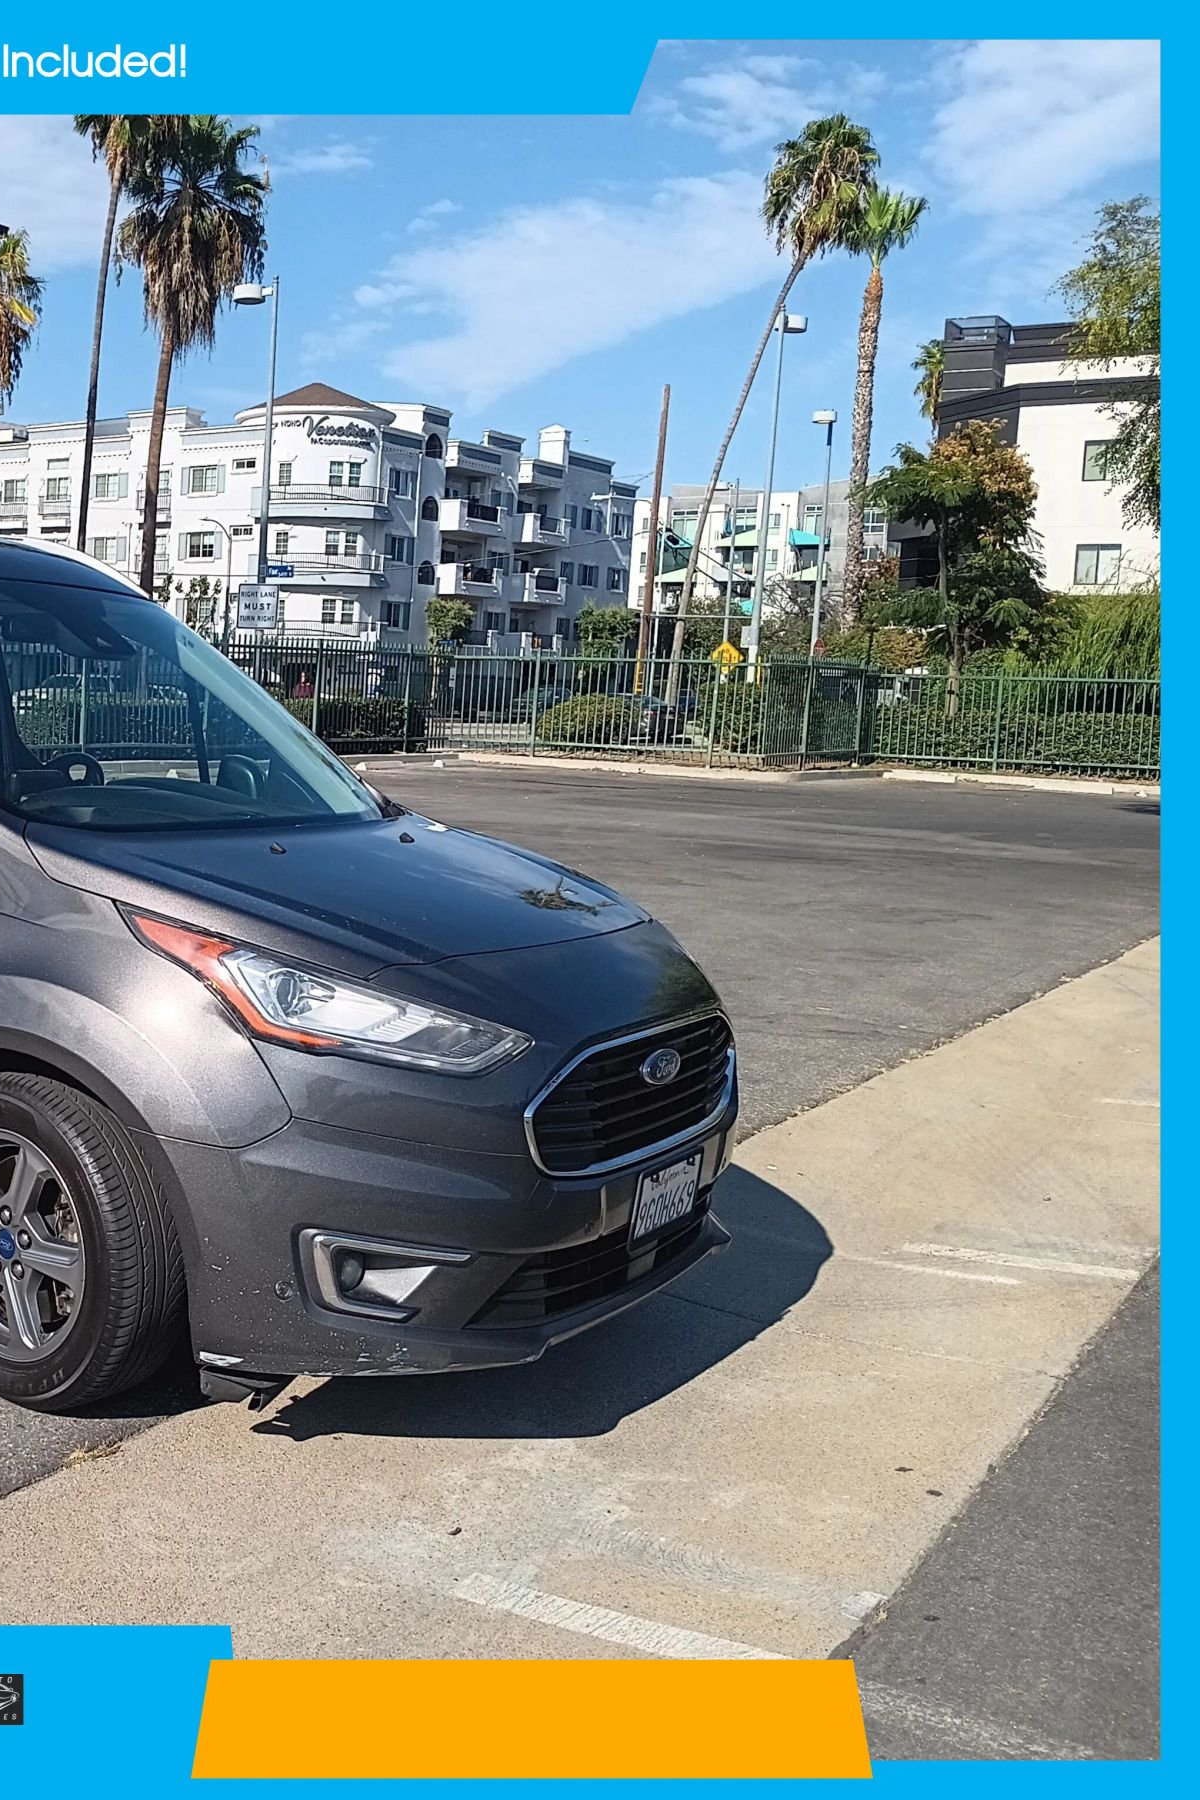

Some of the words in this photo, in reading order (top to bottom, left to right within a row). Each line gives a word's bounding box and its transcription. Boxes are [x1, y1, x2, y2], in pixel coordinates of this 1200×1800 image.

[303, 415, 376, 439] Venetian
[244, 603, 271, 611] MUST
[656, 1055, 676, 1078] Ford
